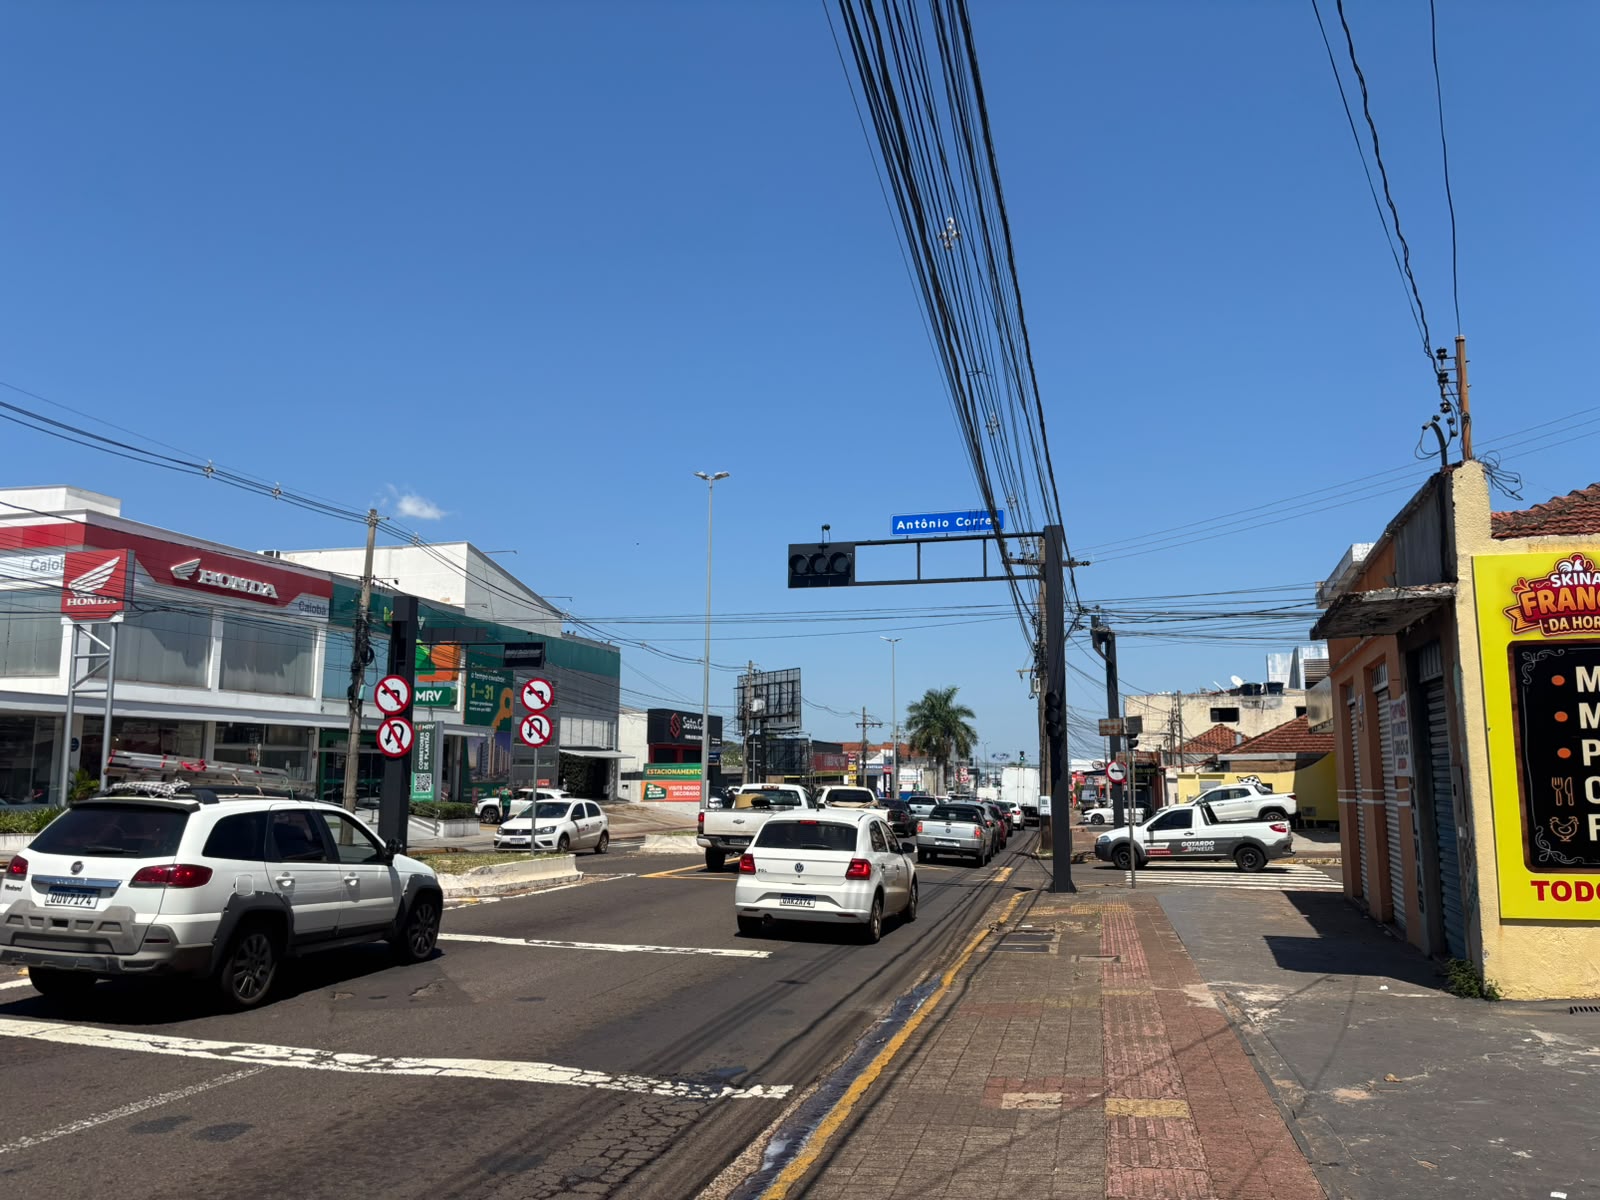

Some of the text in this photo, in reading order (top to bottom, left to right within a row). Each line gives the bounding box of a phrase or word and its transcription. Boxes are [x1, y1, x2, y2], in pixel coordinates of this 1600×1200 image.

[896, 518, 949, 530] Antônio
[198, 568, 278, 599] HONDA
[66, 596, 117, 607] HONDA
[1521, 586, 1600, 617] FRAN
[1549, 616, 1569, 631] DA
[415, 689, 442, 702] MRV
[484, 684, 494, 700] 31
[1530, 880, 1600, 902] TOD
